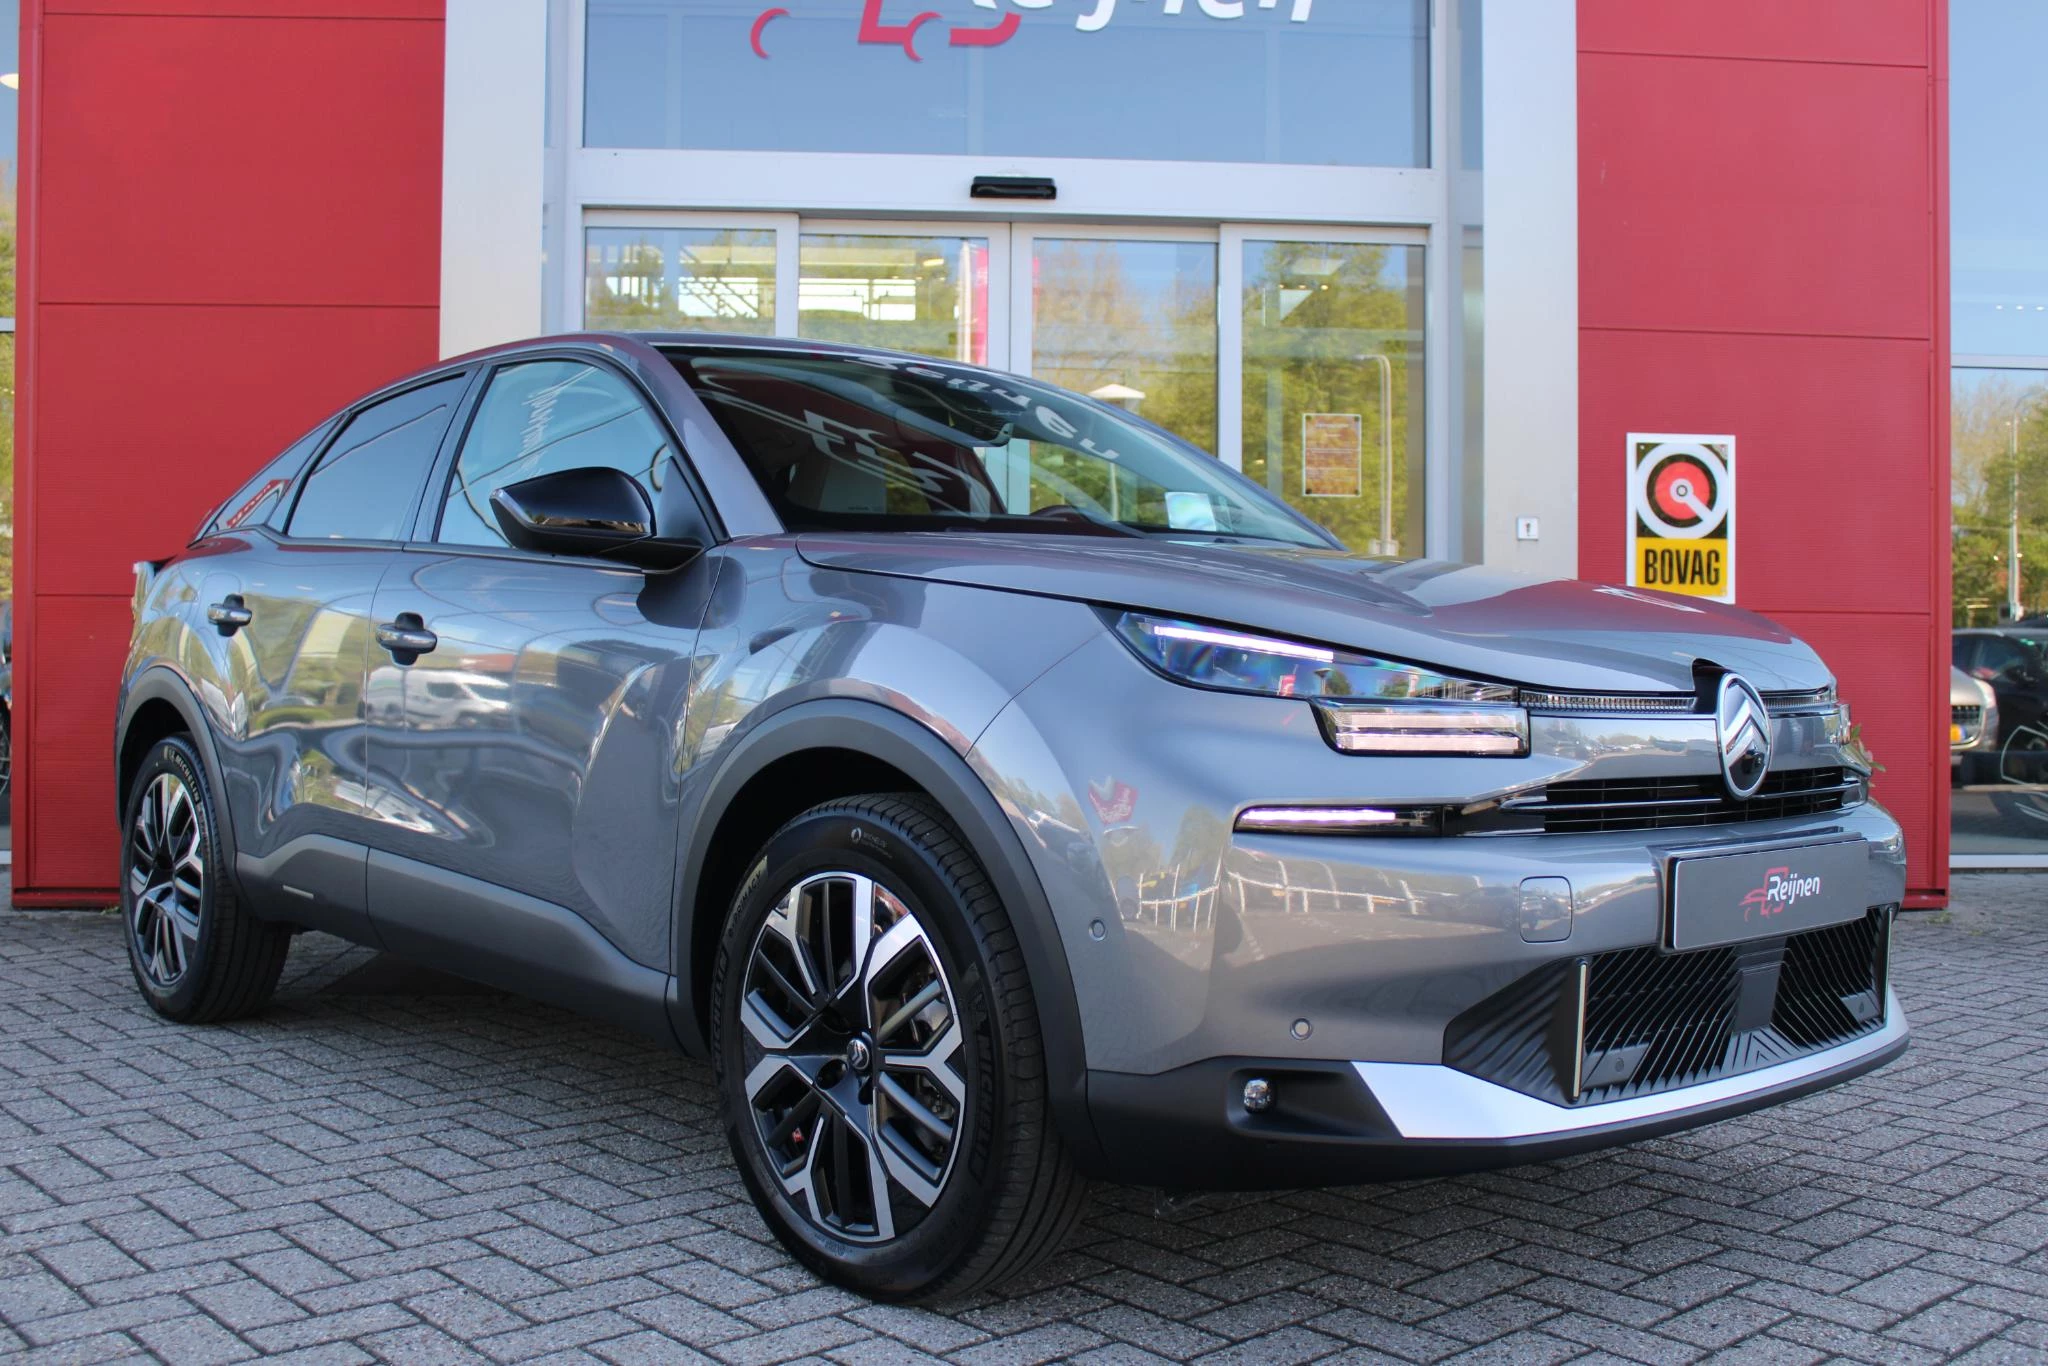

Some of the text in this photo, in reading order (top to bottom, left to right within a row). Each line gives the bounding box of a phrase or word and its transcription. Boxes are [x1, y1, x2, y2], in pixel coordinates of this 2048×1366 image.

[1644, 548, 1720, 586] BOVAG
[175, 755, 200, 802] MICHELIN
[1767, 873, 1821, 904] Reijnen
